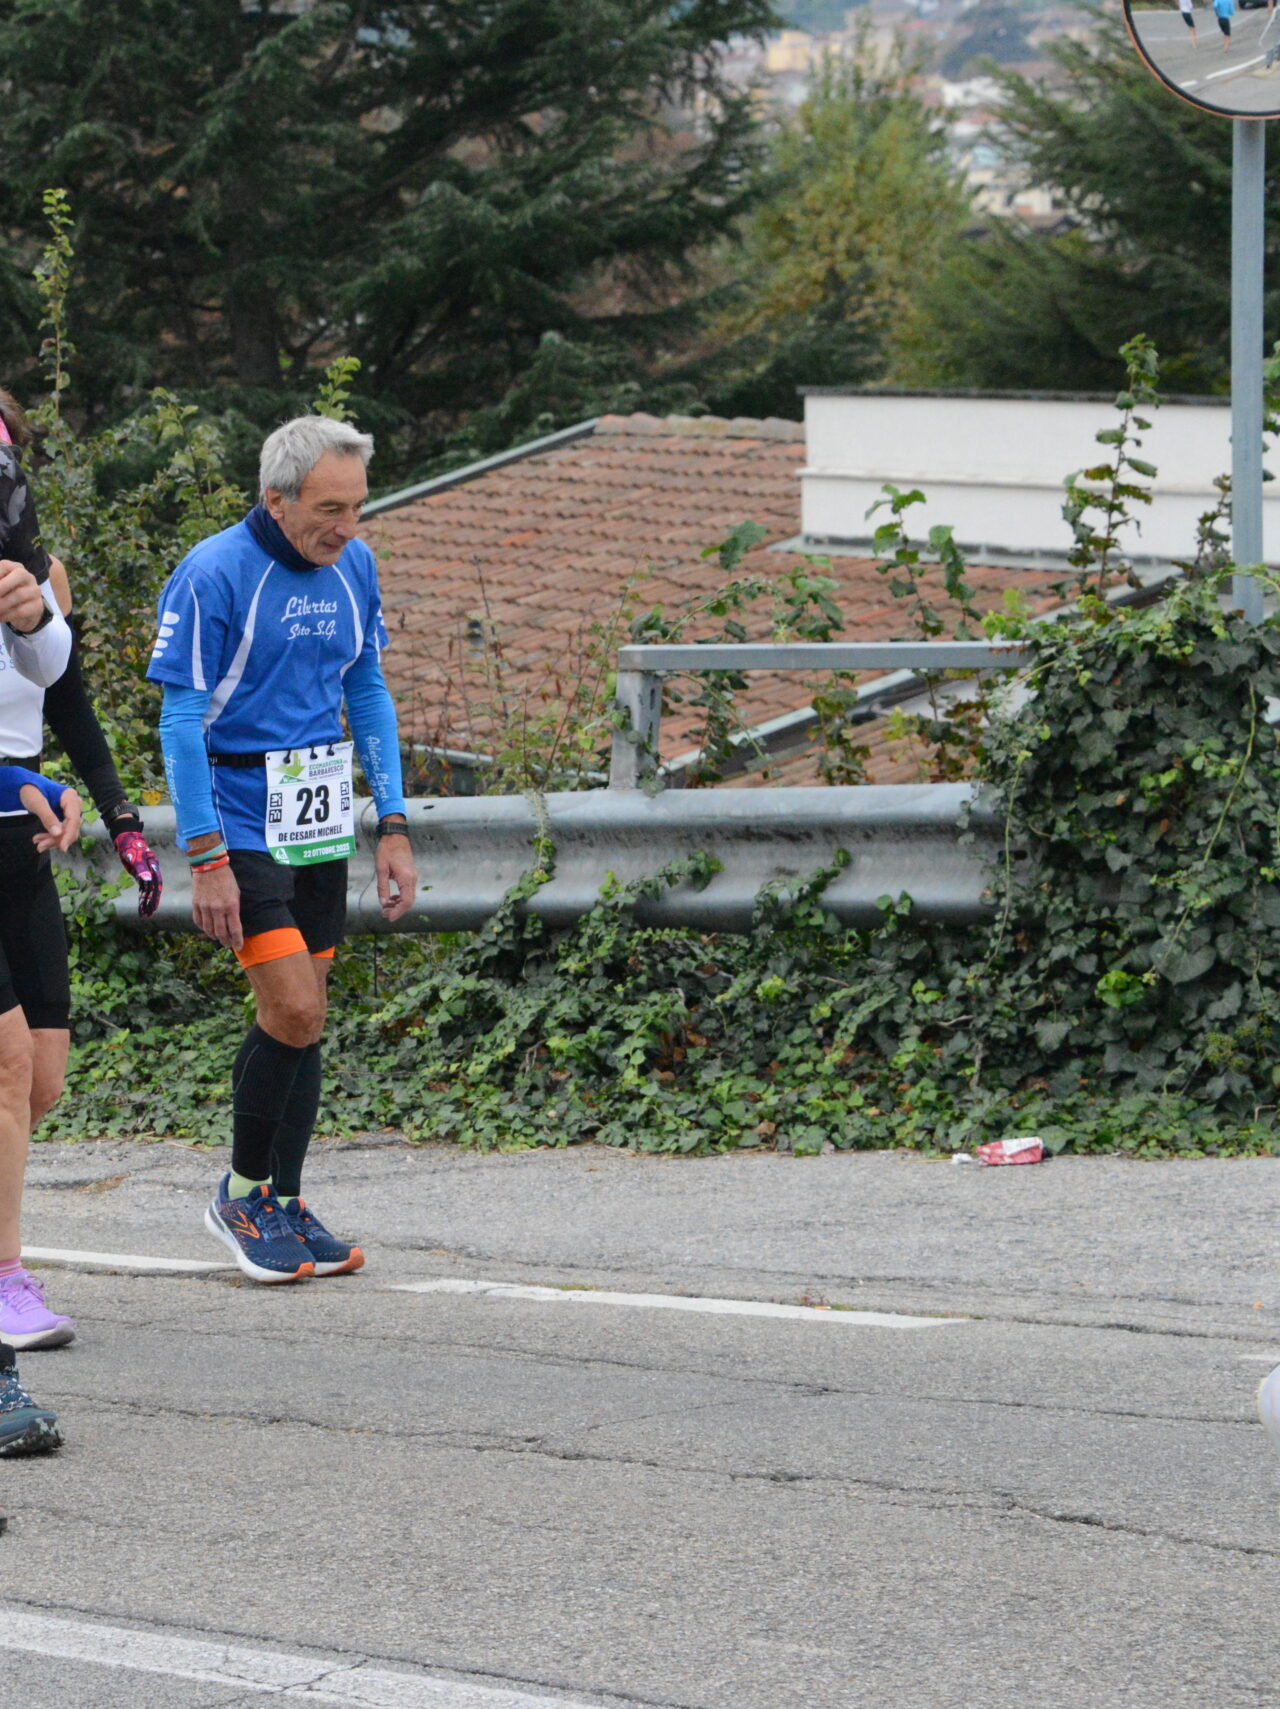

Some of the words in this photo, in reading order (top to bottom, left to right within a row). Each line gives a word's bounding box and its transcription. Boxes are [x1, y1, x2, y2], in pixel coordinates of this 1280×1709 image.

[309, 764, 344, 777] BARBARESCO
[296, 784, 330, 826] 23
[278, 832, 290, 842] DE
[290, 829, 316, 841] CESARE
[317, 824, 343, 838] MICHELE
